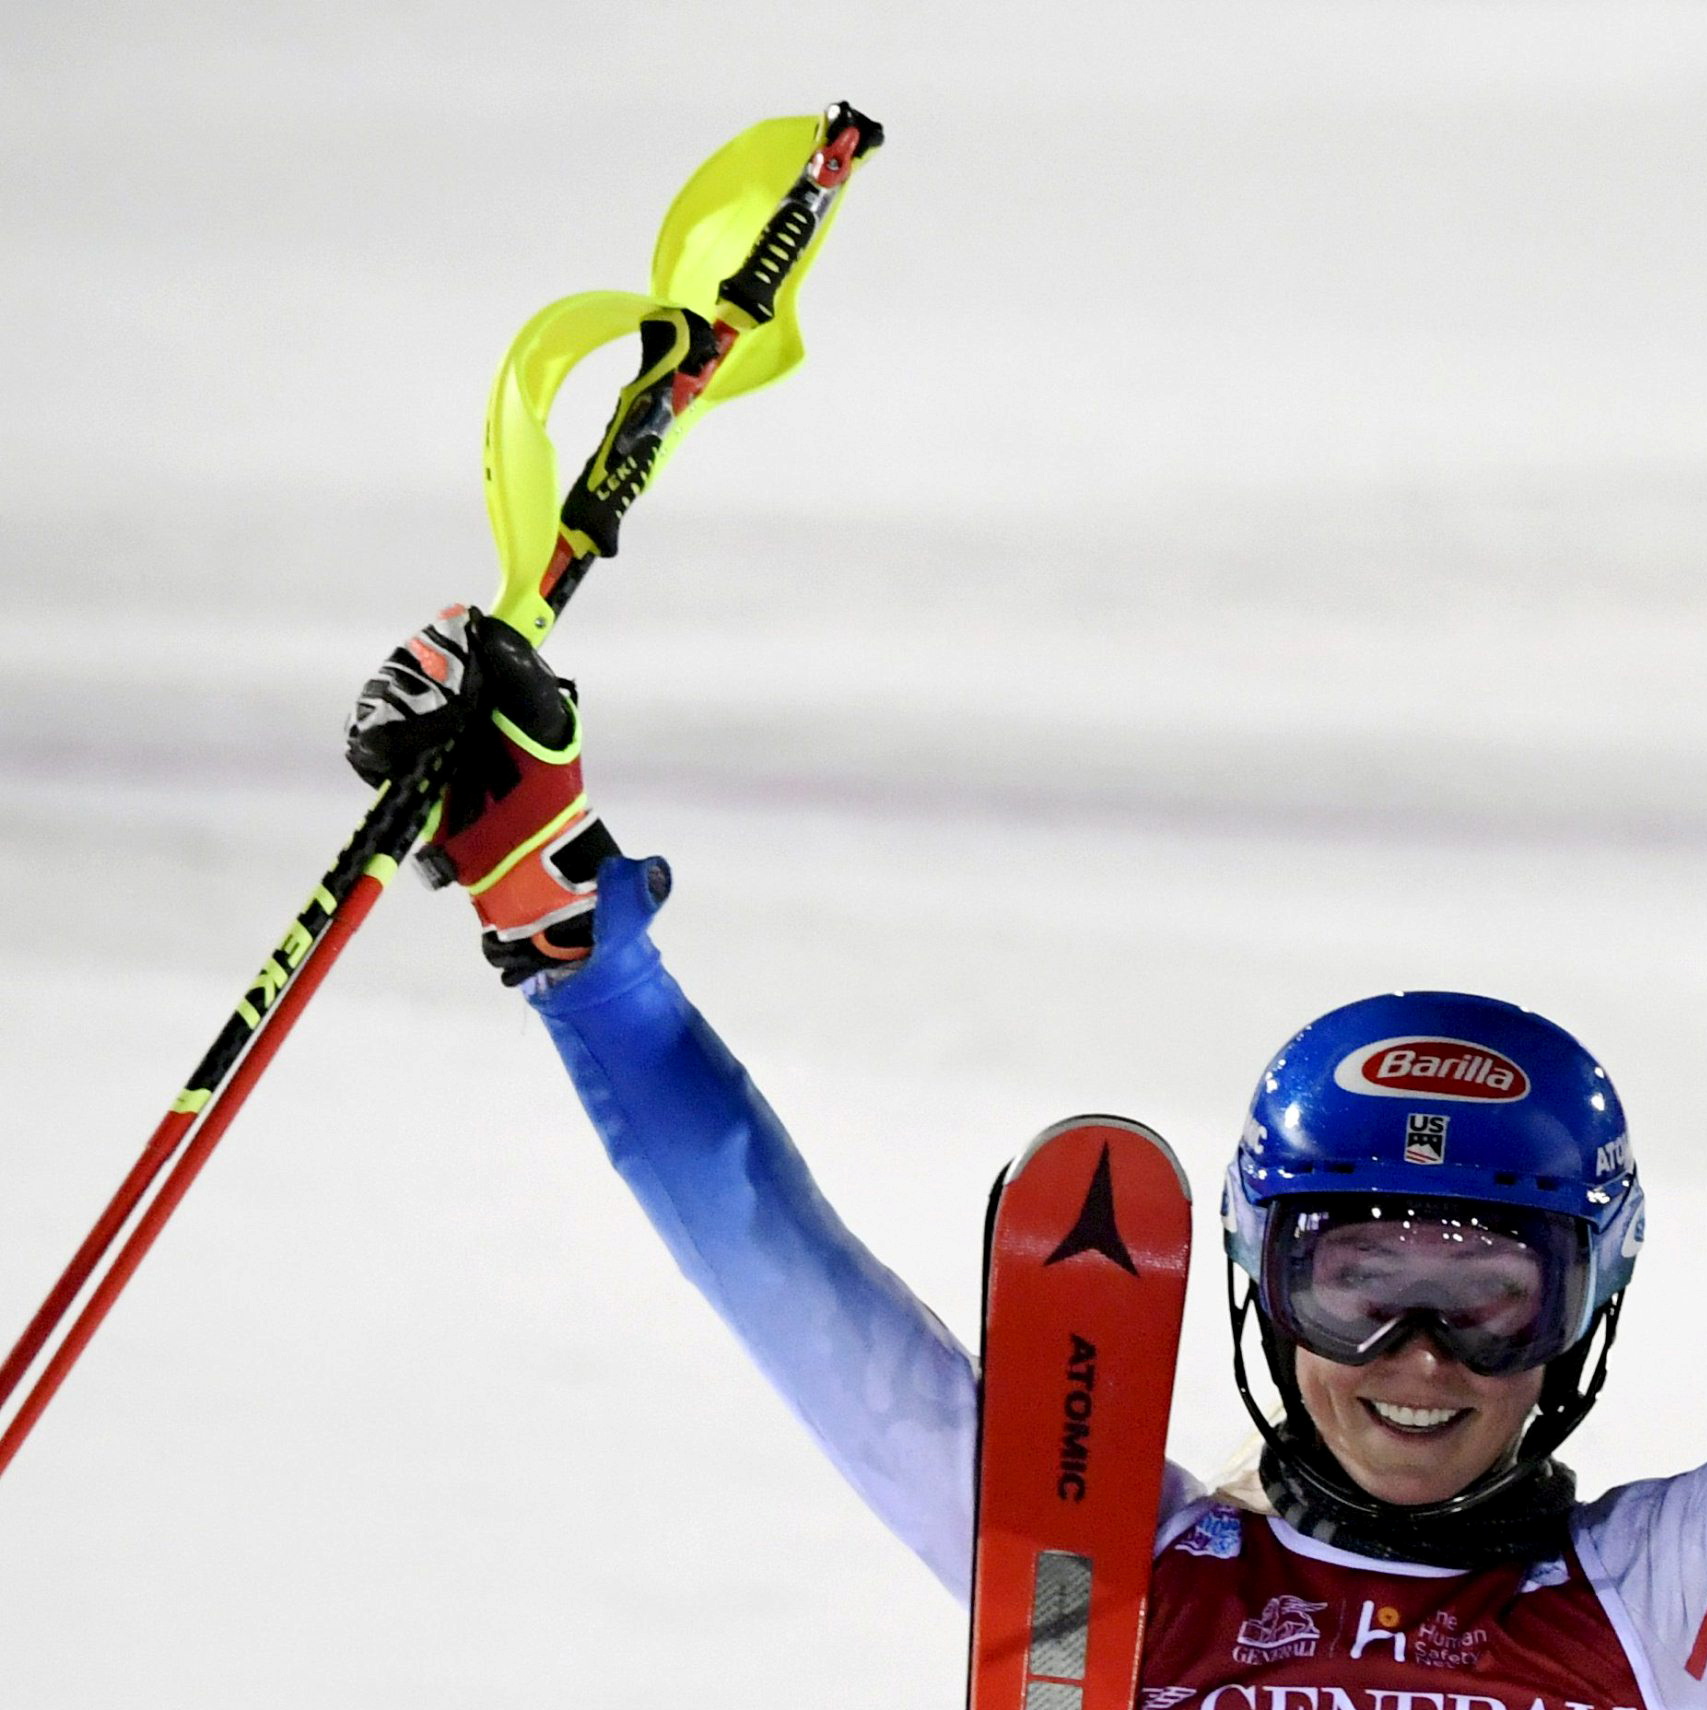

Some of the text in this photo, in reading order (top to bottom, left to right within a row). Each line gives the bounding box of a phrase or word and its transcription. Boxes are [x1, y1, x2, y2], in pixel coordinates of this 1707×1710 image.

[596, 456, 637, 501] LEKI
[230, 882, 338, 1030] LEKI
[1377, 1050, 1514, 1092] Barilla
[1410, 1115, 1444, 1133] US
[1057, 1334, 1098, 1504] ATOMIC
